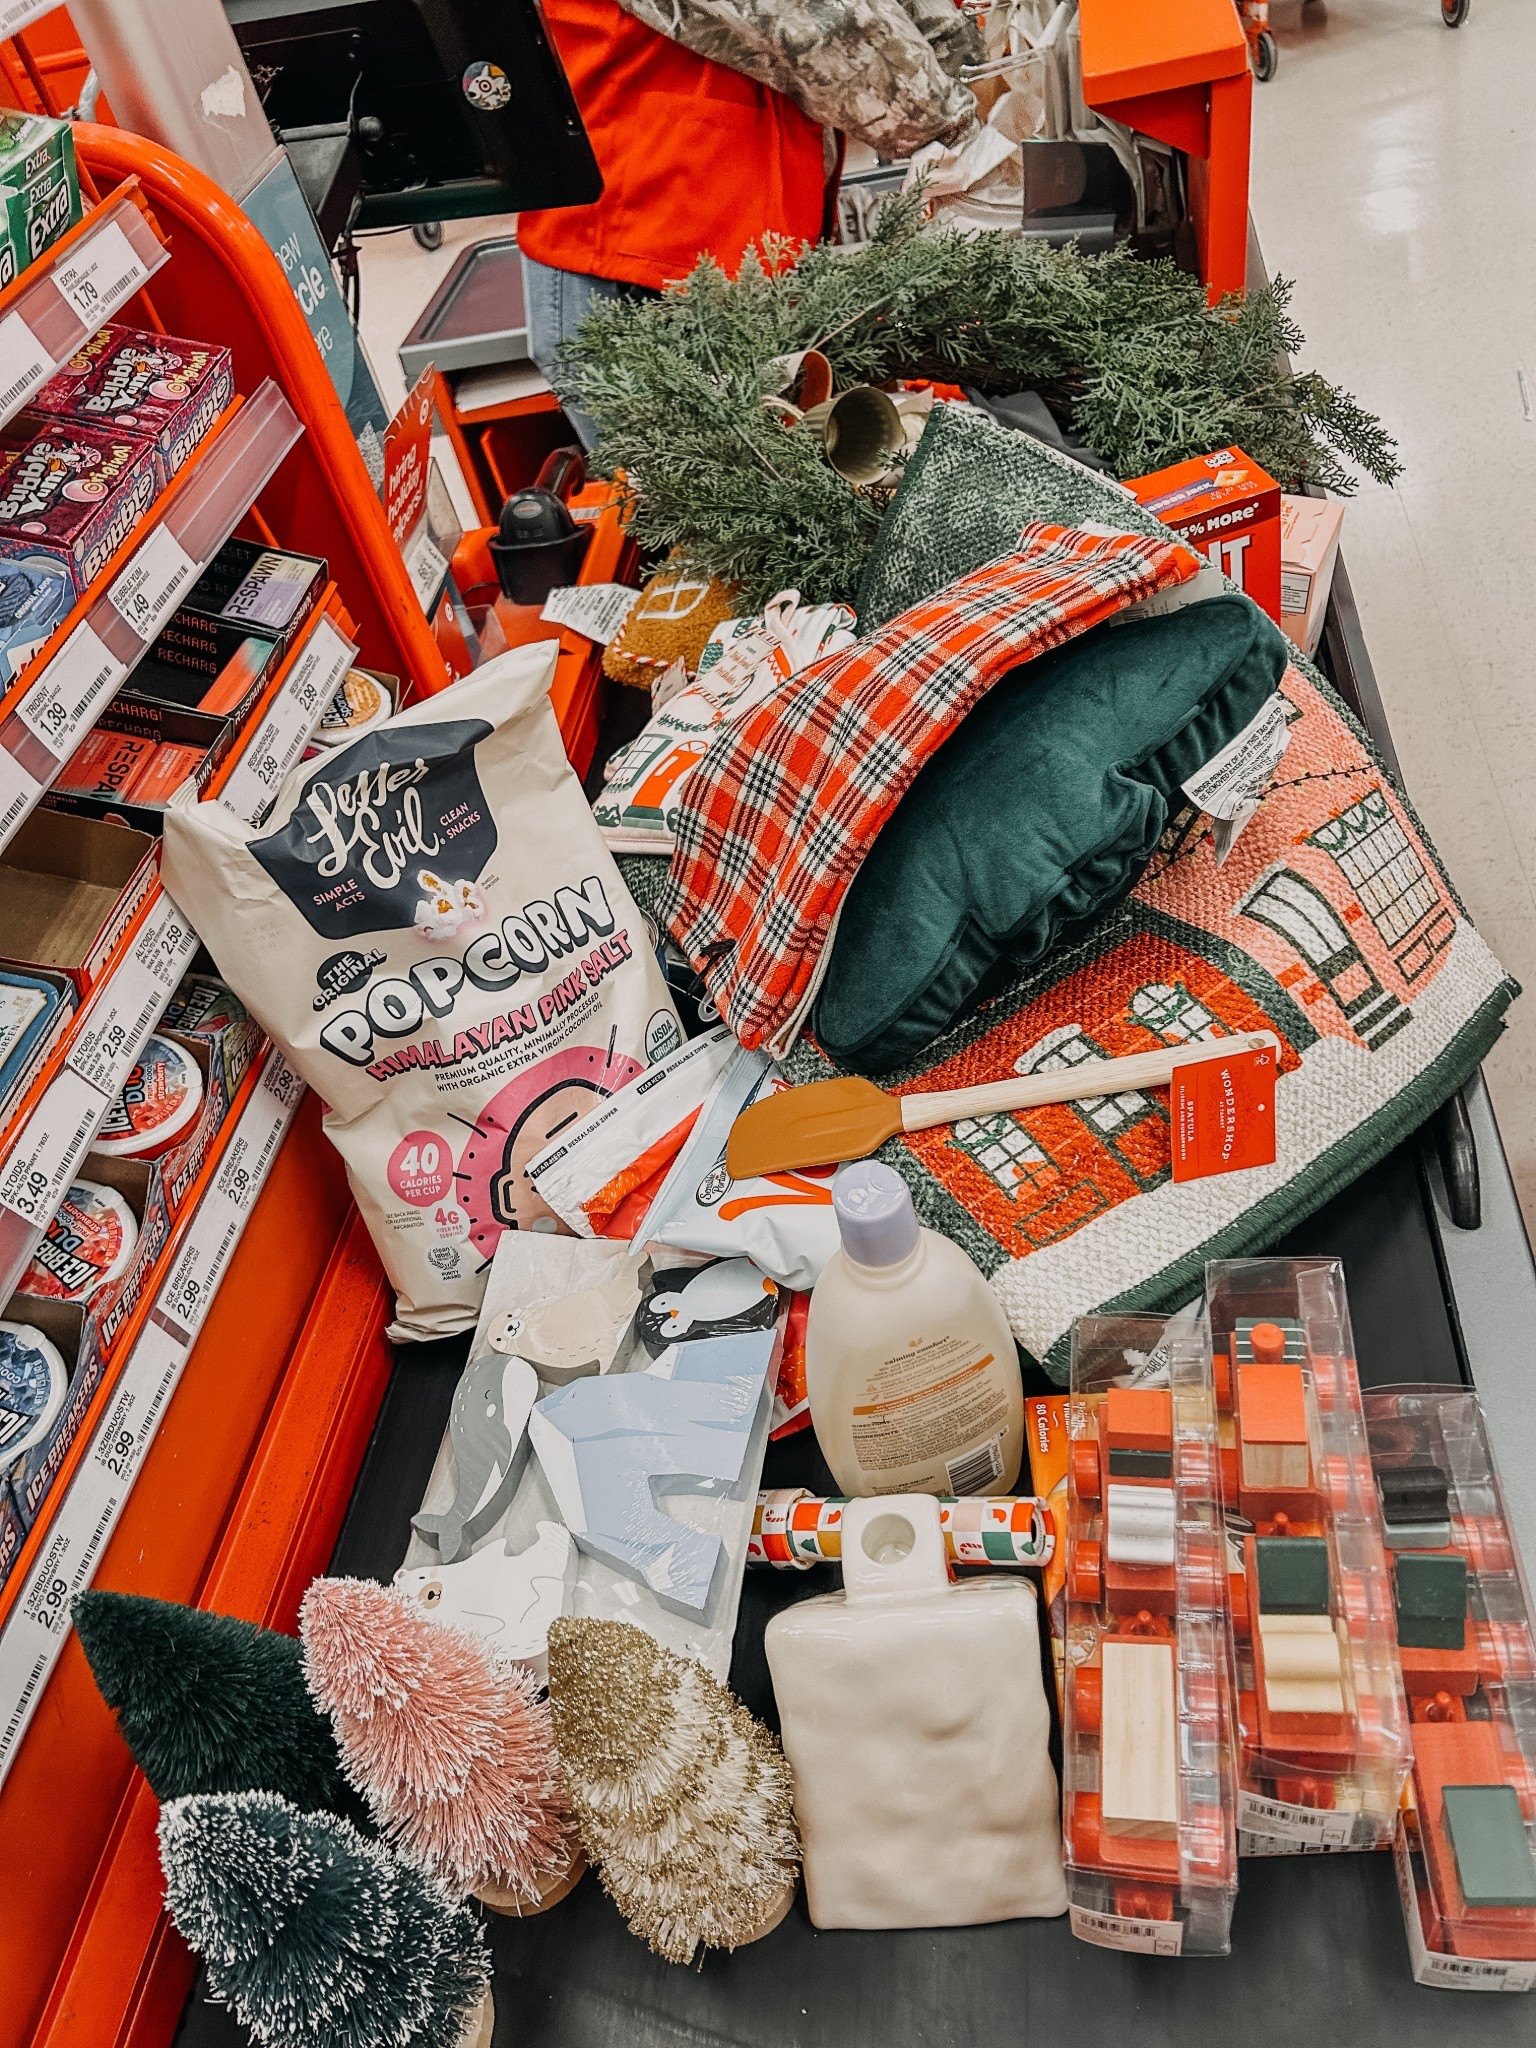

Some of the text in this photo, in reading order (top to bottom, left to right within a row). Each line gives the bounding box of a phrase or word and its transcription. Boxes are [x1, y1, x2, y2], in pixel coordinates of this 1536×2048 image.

[25, 148, 50, 180] Extra
[30, 176, 51, 205] Extra
[30, 184, 68, 258] Extra
[60, 268, 77, 287] EXTRA
[74, 281, 98, 309] 1.79
[85, 347, 137, 412] Bubble
[110, 371, 152, 411] Yum
[168, 351, 209, 393] Original
[171, 377, 228, 472] Bubble
[0, 442, 52, 518] Bubble
[83, 445, 132, 494] Original
[17, 469, 66, 516] Yum
[84, 474, 152, 584] Bubble
[109, 579, 133, 605] BUBBLE
[130, 566, 142, 582] YUM
[227, 555, 282, 615] RESPAWN
[126, 593, 149, 623] 1.49
[25, 686, 49, 716] TRIDENT
[40, 702, 67, 735] 1.39
[299, 684, 317, 711] 2.99
[258, 755, 278, 785] 2.99
[1191, 706, 1282, 797] UNDER PENALTY OF LAW THIS TAG NOT TO
[1199, 792, 1208, 802] BE
[1205, 773, 1230, 795] REMOVED
[1228, 757, 1248, 775] EXCEPT
[1246, 750, 1255, 759] BY
[1254, 740, 1264, 751] THE
[440, 802, 469, 827] CLEAN
[447, 811, 482, 839] SNACKS
[360, 786, 440, 889] Evil
[312, 878, 359, 906] SIMPLE
[335, 891, 366, 912] ACTS
[135, 928, 155, 960] ALTOIDS
[152, 925, 182, 976] NOW 2.59
[313, 948, 387, 1012] ORIGINAL
[320, 876, 616, 1066] POPCORN
[323, 954, 355, 982] THE
[366, 929, 633, 1082] HIMALAYAN PINK SALT
[72, 1031, 95, 1067] ALTOIDS
[434, 992, 599, 1082] PREMIUM QUALITY, MINIMALLY PROCESSED
[437, 1001, 603, 1093] WITH ORGANIC EXTRA VIRGIN COCONUT OIL
[651, 1019, 673, 1044] USDA
[79, 1045, 96, 1071] BPK-ALTD
[85, 1063, 95, 1076] WAS
[92, 1025, 126, 1082] NOW 2.59
[638, 1081, 653, 1095] TEAR
[666, 1051, 695, 1073] RESEALABLE
[694, 1043, 709, 1055] ZIPPER
[156, 1062, 166, 1100] strawberry
[272, 1069, 293, 1102] 2.99
[1186, 1100, 1195, 1143] SPATULA
[1220, 1068, 1236, 1160] WONDERSHOP
[171, 1090, 223, 1209] ICE BREAKERS
[400, 1142, 439, 1176] 40
[532, 1107, 619, 1178] TEAR HERE RESEALABLE ZIPPER
[0, 1159, 26, 1201] ALTOIDS
[8, 1174, 27, 1205] BPK-ALTD
[24, 1153, 38, 1174] PPMNT
[217, 1137, 246, 1191] ICE BREAKERS
[400, 1175, 442, 1189] CALORIES
[17, 1172, 48, 1214] 3.49
[228, 1168, 249, 1204] 2.99
[405, 1186, 441, 1198] PER CUP
[61, 1201, 101, 1233] strawberry
[393, 1222, 424, 1230] INFORMATION
[434, 1207, 460, 1226] 4G
[165, 1246, 198, 1306] ICE BREAKERS
[434, 1251, 451, 1259] label
[102, 1294, 125, 1346] ICE
[122, 1214, 172, 1299] BREAKERS
[171, 1288, 181, 1303] DUO
[173, 1280, 204, 1319] 2.99
[884, 1351, 916, 1366] calming
[25, 1356, 99, 1513] ICE BREAKERS
[95, 1390, 133, 1460] 1.3ZIBDUOSTW
[104, 1443, 113, 1458] DUO
[109, 1412, 127, 1443] STRWBRY
[1036, 1404, 1050, 1453] 80 Calories
[103, 1431, 134, 1475] 2.99
[23, 1534, 68, 1614] 1.3ZIBDUOSTW
[34, 1594, 44, 1611] DUO
[40, 1558, 60, 1594] STRWBRY
[38, 1579, 67, 1629] 2.99
